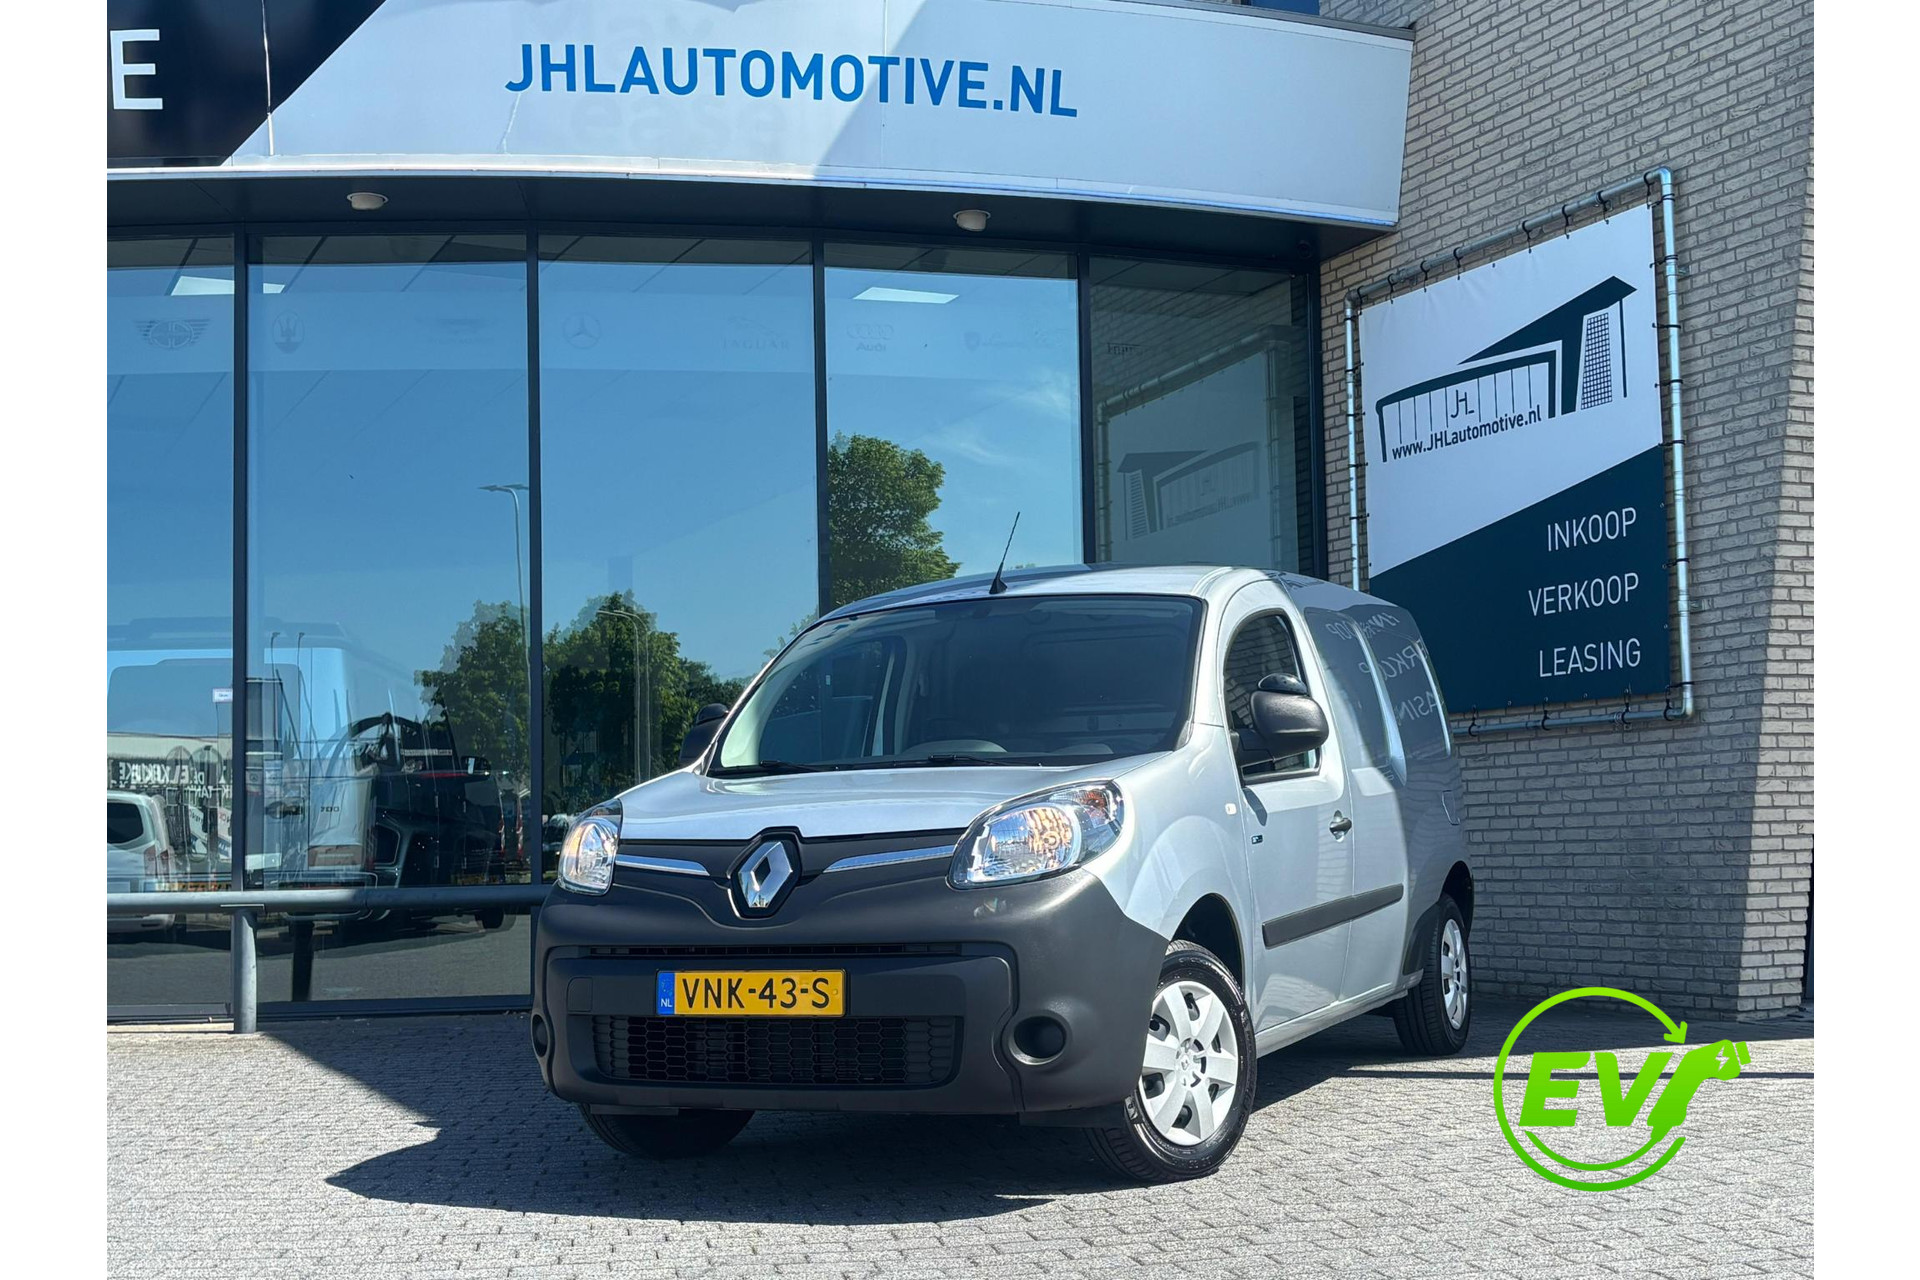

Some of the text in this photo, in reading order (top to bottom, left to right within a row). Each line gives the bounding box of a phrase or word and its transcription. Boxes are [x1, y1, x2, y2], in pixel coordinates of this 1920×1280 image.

[109, 29, 163, 110] E
[505, 43, 1078, 118] JHLAUTOMOTIVE.NL
[1391, 404, 1542, 460] www.JHLautomotive.nl
[1547, 507, 1637, 552] INKOOP
[1528, 572, 1639, 617] VERKOOP
[1539, 637, 1641, 678] LEASING
[660, 998, 673, 1008] NL
[682, 978, 830, 1009] VNK-43-S
